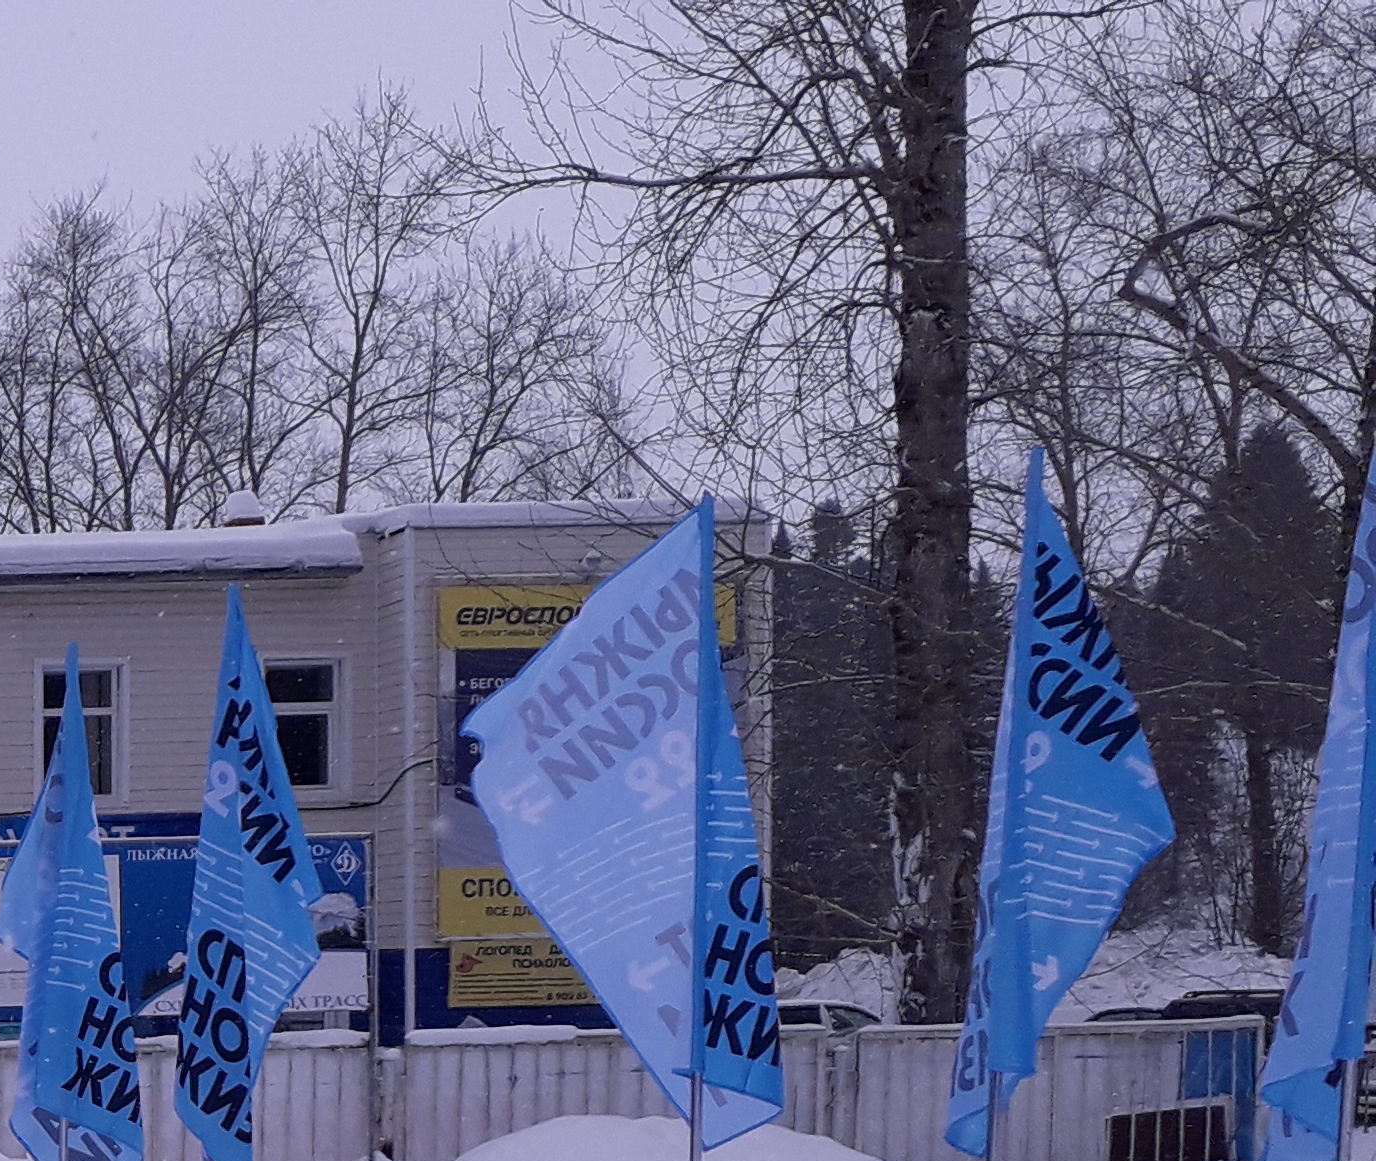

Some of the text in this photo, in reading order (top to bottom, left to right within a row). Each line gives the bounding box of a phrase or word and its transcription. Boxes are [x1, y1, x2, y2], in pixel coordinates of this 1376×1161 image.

[456, 605, 581, 626] ЕВРОСПО
[461, 878, 519, 898] СПО
[485, 906, 509, 917] ВСЕ
[311, 995, 367, 1008] ТРАСС
